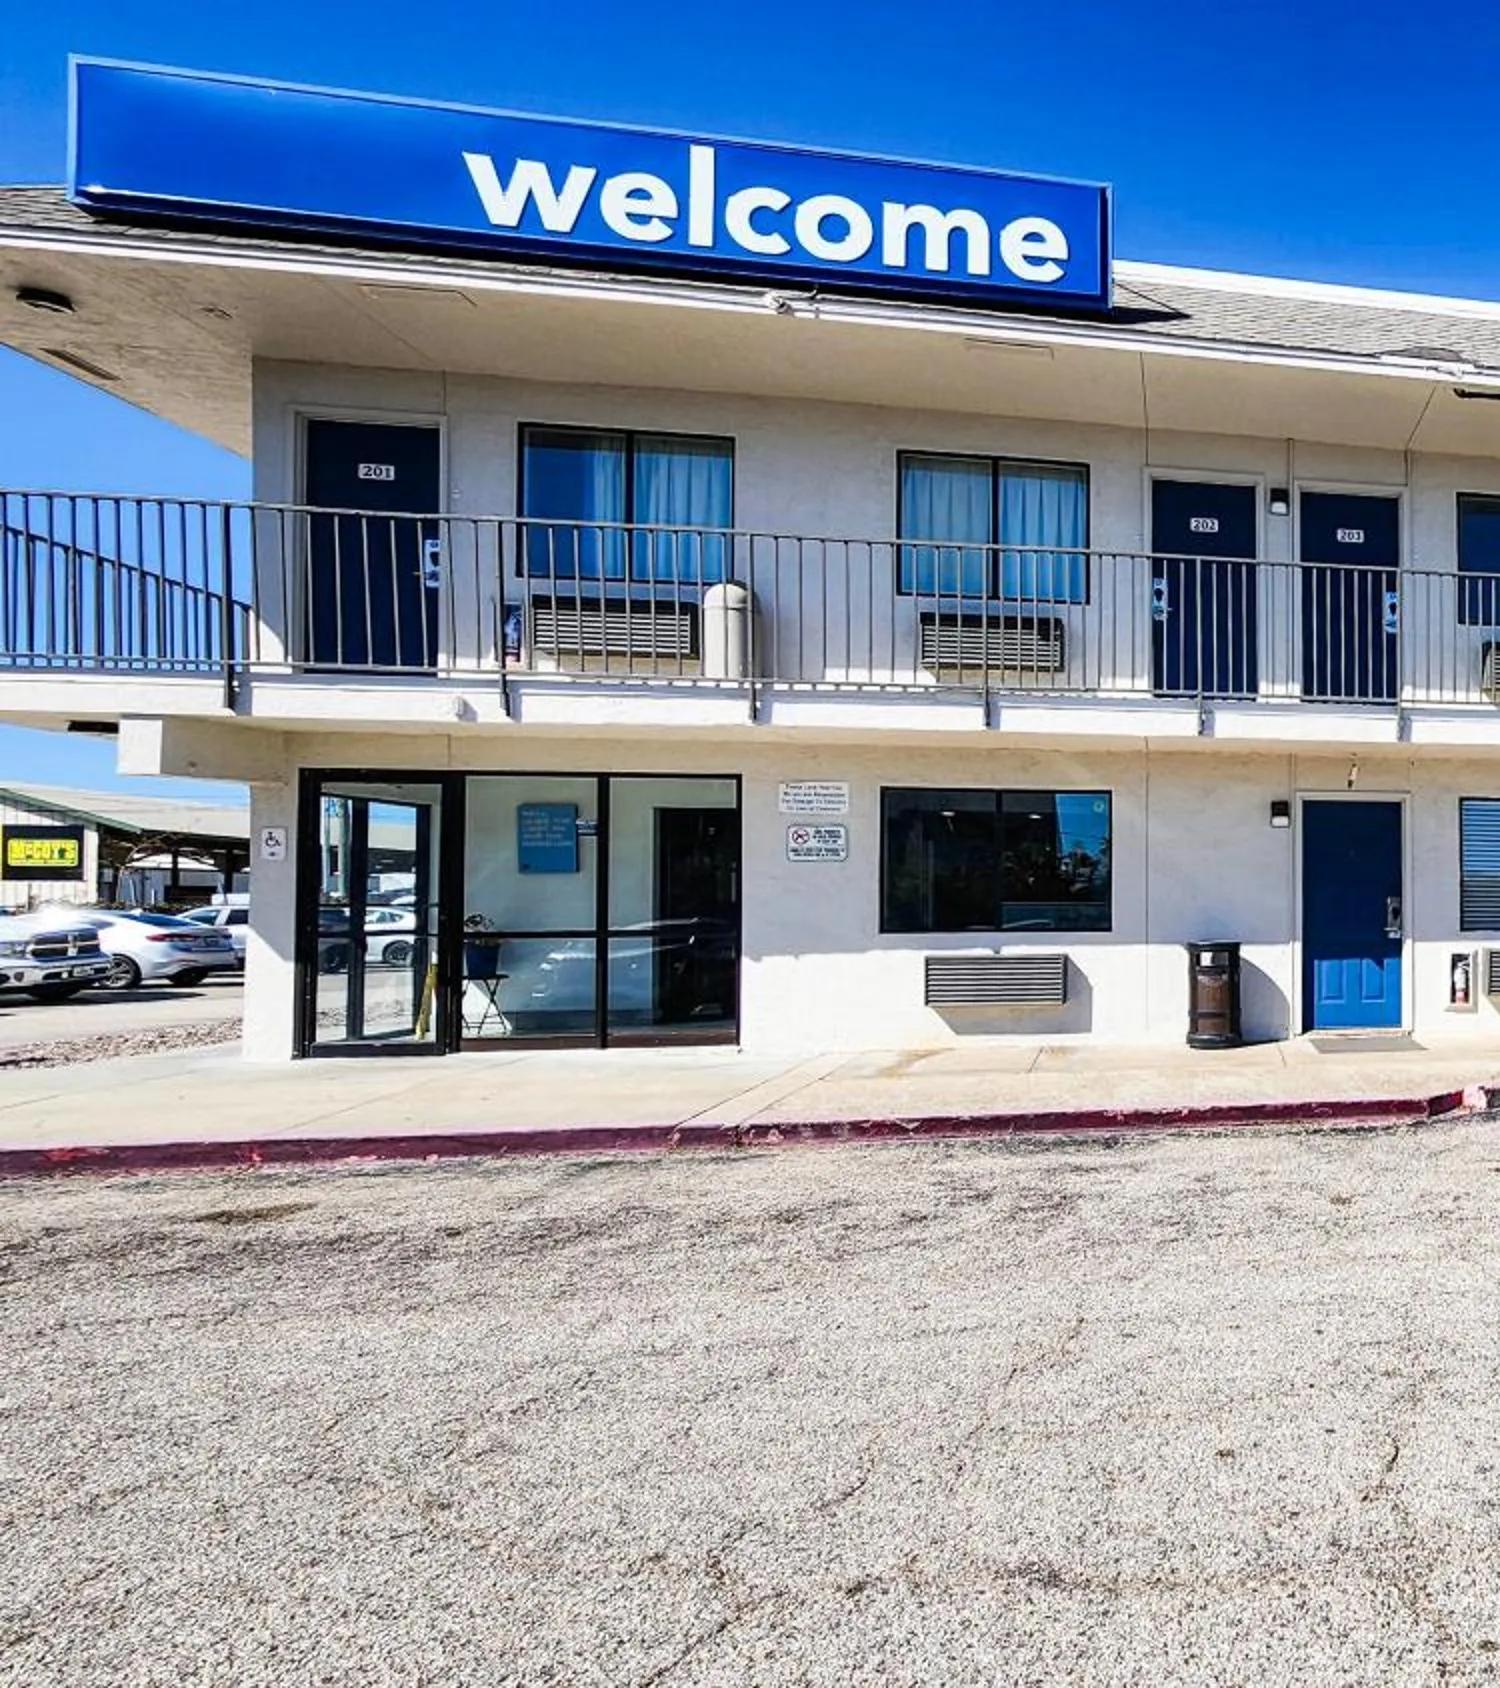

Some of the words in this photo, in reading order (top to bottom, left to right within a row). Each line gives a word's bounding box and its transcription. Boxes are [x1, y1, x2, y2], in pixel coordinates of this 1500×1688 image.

[462, 144, 1069, 283] welcome
[362, 465, 393, 479] 201
[1192, 519, 1216, 531] 202
